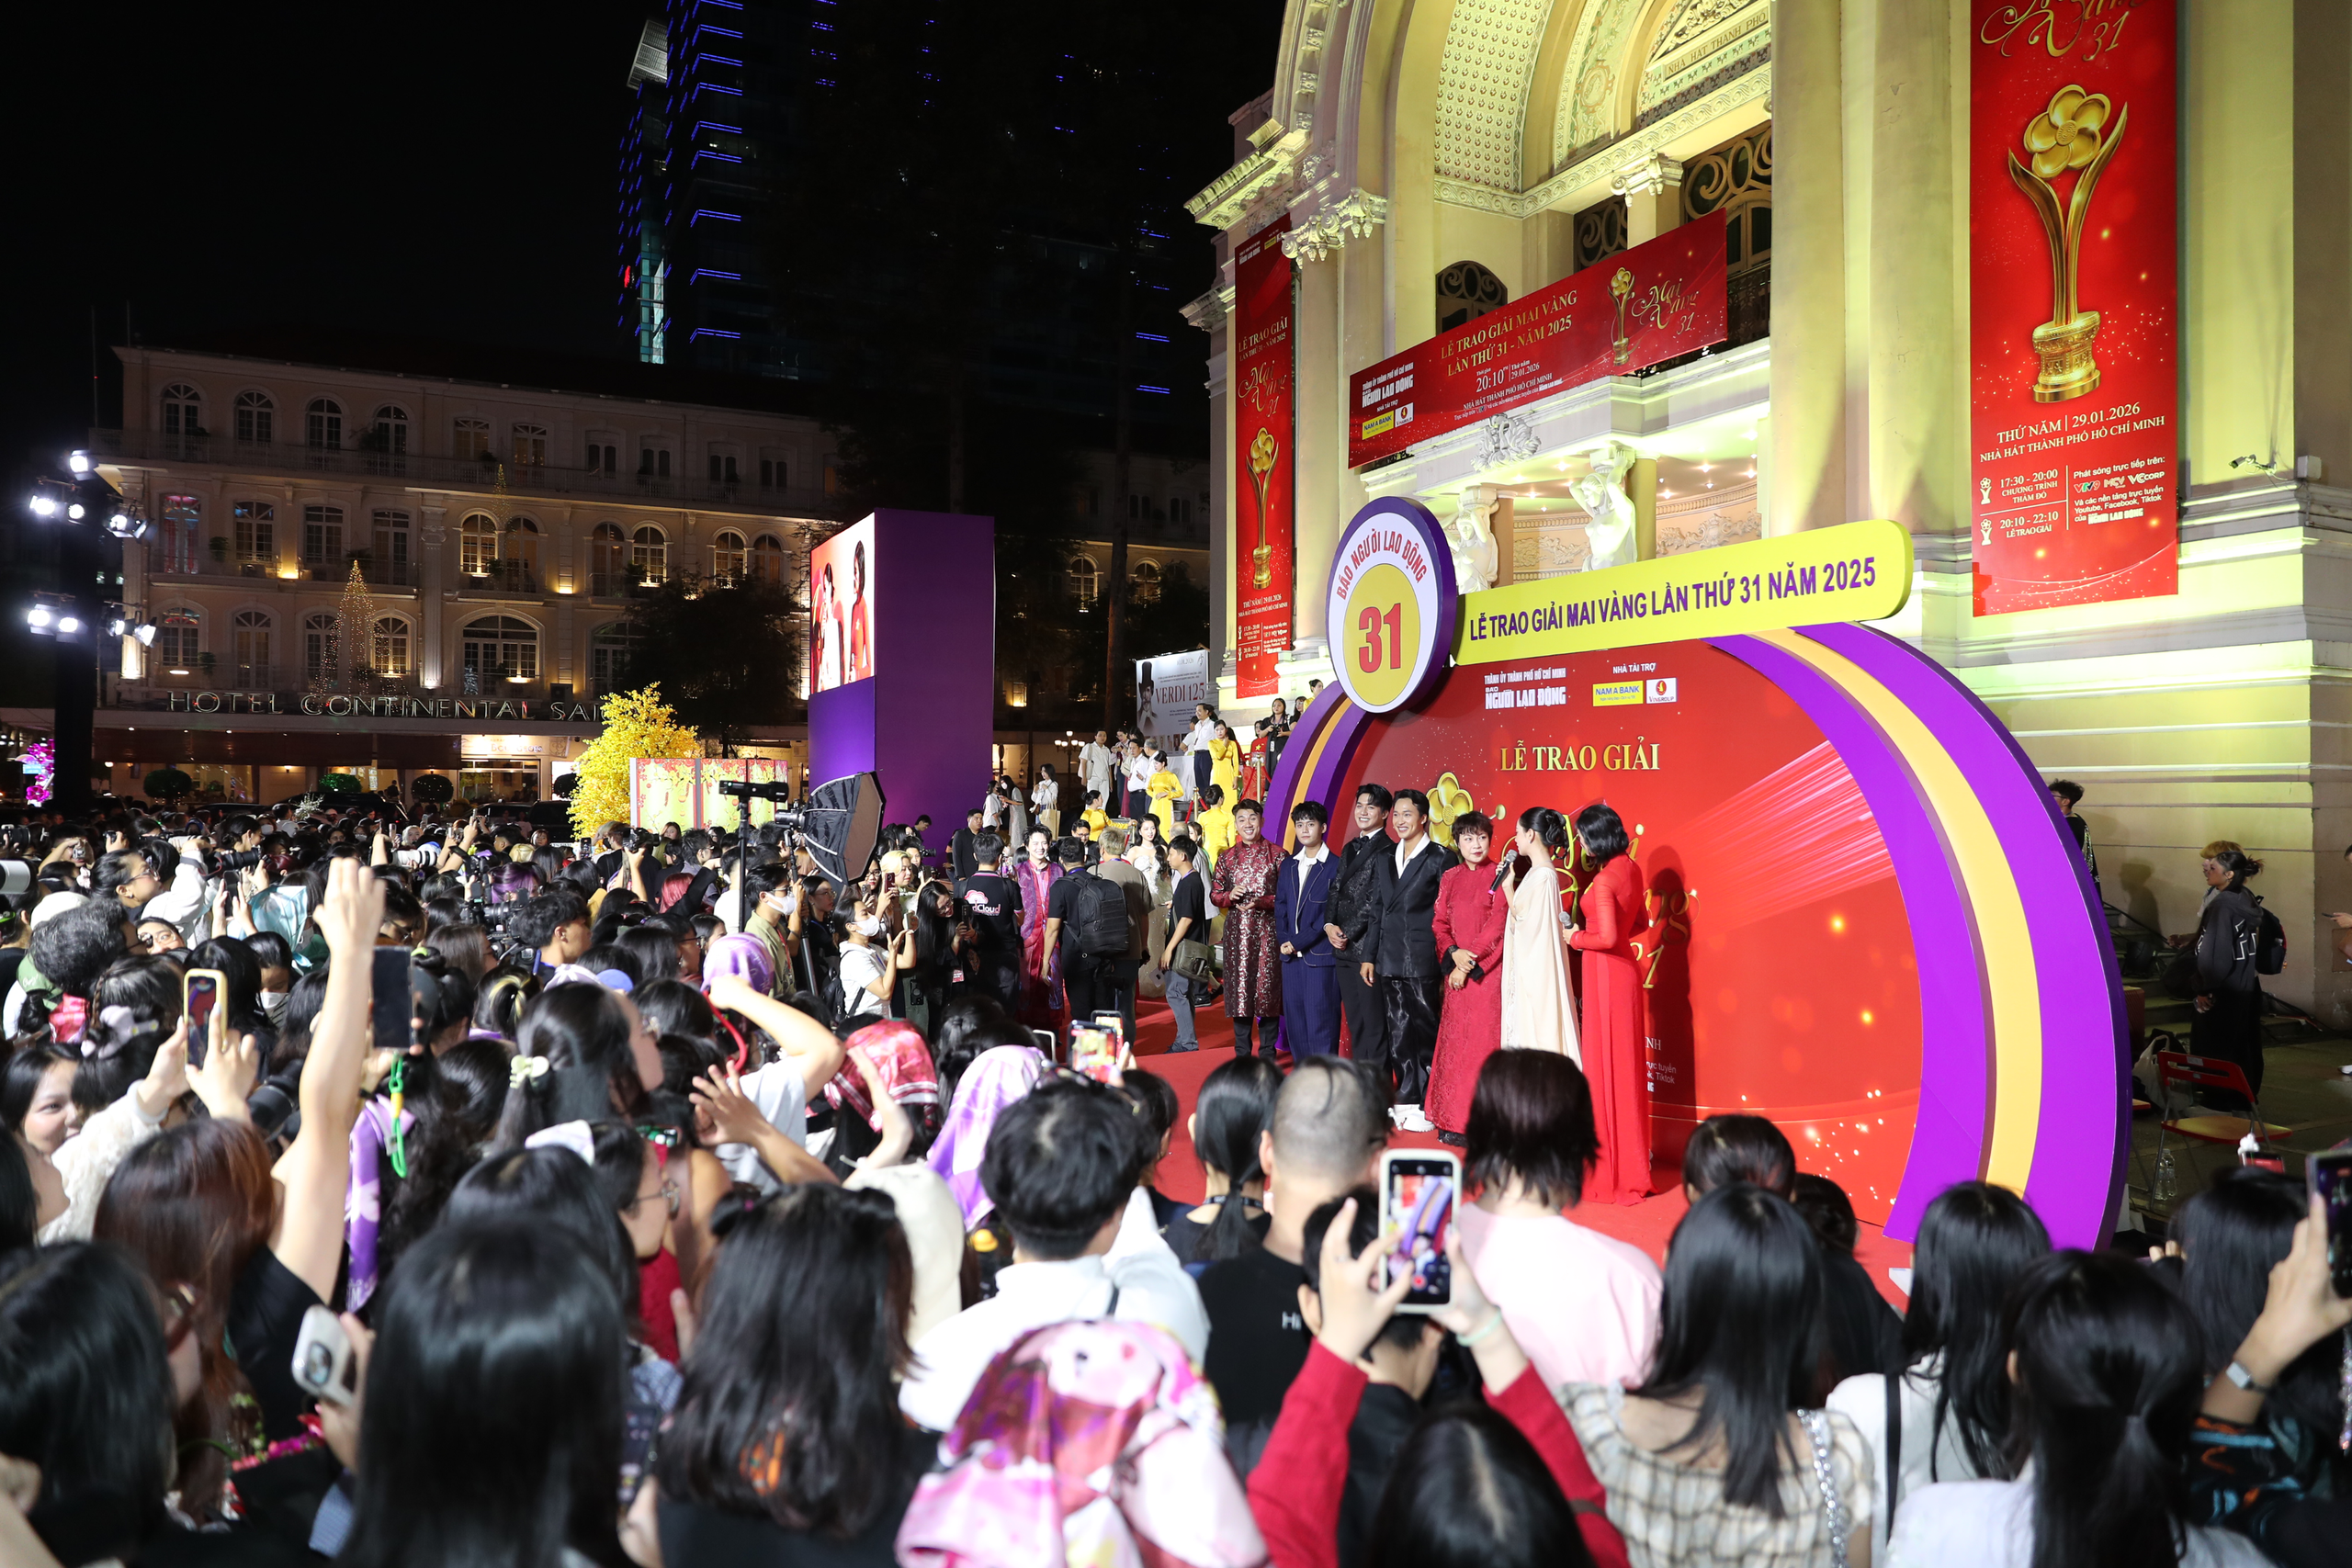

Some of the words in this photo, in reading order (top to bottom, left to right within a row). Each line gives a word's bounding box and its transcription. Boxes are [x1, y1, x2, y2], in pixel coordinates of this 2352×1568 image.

[2082, 11, 2130, 62] 31
[1249, 327, 1269, 347] TRAO
[1271, 316, 1288, 334] GIẢI
[1456, 330, 1487, 354] TRAO
[1488, 316, 1513, 339] GIẢI
[1516, 306, 1540, 328] MAI
[1542, 290, 1577, 316] VÀNG
[1677, 312, 1694, 334] 31
[1471, 344, 1496, 367] THỨ
[1497, 341, 1508, 357] 31
[1517, 326, 1545, 349] NĂM
[1547, 314, 1572, 337] 2025
[1476, 369, 1505, 392] 20:10
[1537, 373, 1553, 386] MINH
[1382, 382, 1395, 400] LAO
[1266, 395, 1279, 417] 31
[1378, 415, 1392, 424] BANK
[1996, 424, 2027, 445] THỨ
[2029, 419, 2062, 437] NĂM
[2072, 402, 2141, 428] 29.01.2026
[1980, 447, 2002, 463] NHÀ
[2004, 442, 2025, 457] HÁT
[2027, 437, 2064, 454] THÀNH
[2109, 421, 2130, 435] CHÍ
[2132, 415, 2165, 432] MINH
[2000, 476, 2024, 489] 17:30
[2032, 468, 2058, 481] 20:00
[2074, 469, 2091, 479] Phát
[2093, 467, 2111, 476] sóng
[2113, 463, 2129, 472] trực
[2001, 485, 2033, 496] CHƯƠNG
[2035, 480, 2058, 491] TRÌNH
[2012, 494, 2034, 503] THẢM
[2141, 494, 2162, 503] Tiktok
[2000, 516, 2025, 529] 20:10
[2032, 511, 2059, 524] 22:10
[2016, 526, 2036, 536] TRAO
[2036, 524, 2052, 534] GIẢI
[1336, 565, 1353, 600] BÁO
[1351, 528, 1381, 570] NGƯỜI
[1384, 531, 1402, 553] LAO
[1402, 542, 1428, 583] ĐỘNG
[1470, 612, 1487, 641] LỄ
[1489, 614, 1529, 637] TRAO
[1532, 604, 1562, 632] GIẢI
[1567, 603, 1596, 628] MAI
[1599, 591, 1647, 624] VÀNG
[1651, 581, 1689, 615] LẦN
[1692, 571, 1736, 608] THỨ
[1740, 576, 1761, 603] 31
[1768, 562, 1817, 599] NĂM
[1823, 557, 1876, 592] 2025
[1358, 603, 1401, 673] 31
[1612, 663, 1627, 674] NHÀ
[1628, 663, 1639, 672] TÀI
[1641, 662, 1657, 672] TRỢ
[1156, 685, 1185, 704] VERDI
[1189, 682, 1204, 701] 125
[1485, 689, 1514, 709] NGƯỜI
[1516, 689, 1535, 707] LAO
[1537, 686, 1566, 706] ĐỘNG
[1620, 685, 1640, 694] BANK
[167, 691, 284, 714] HOTEL
[300, 694, 535, 720] CONTINENTAL
[1500, 739, 1527, 771] LỄ
[1532, 745, 1597, 771] TRAO
[1603, 736, 1660, 771] GIẢI
[972, 904, 1001, 913] dCloud
[1656, 1072, 1675, 1084] Tiktok
